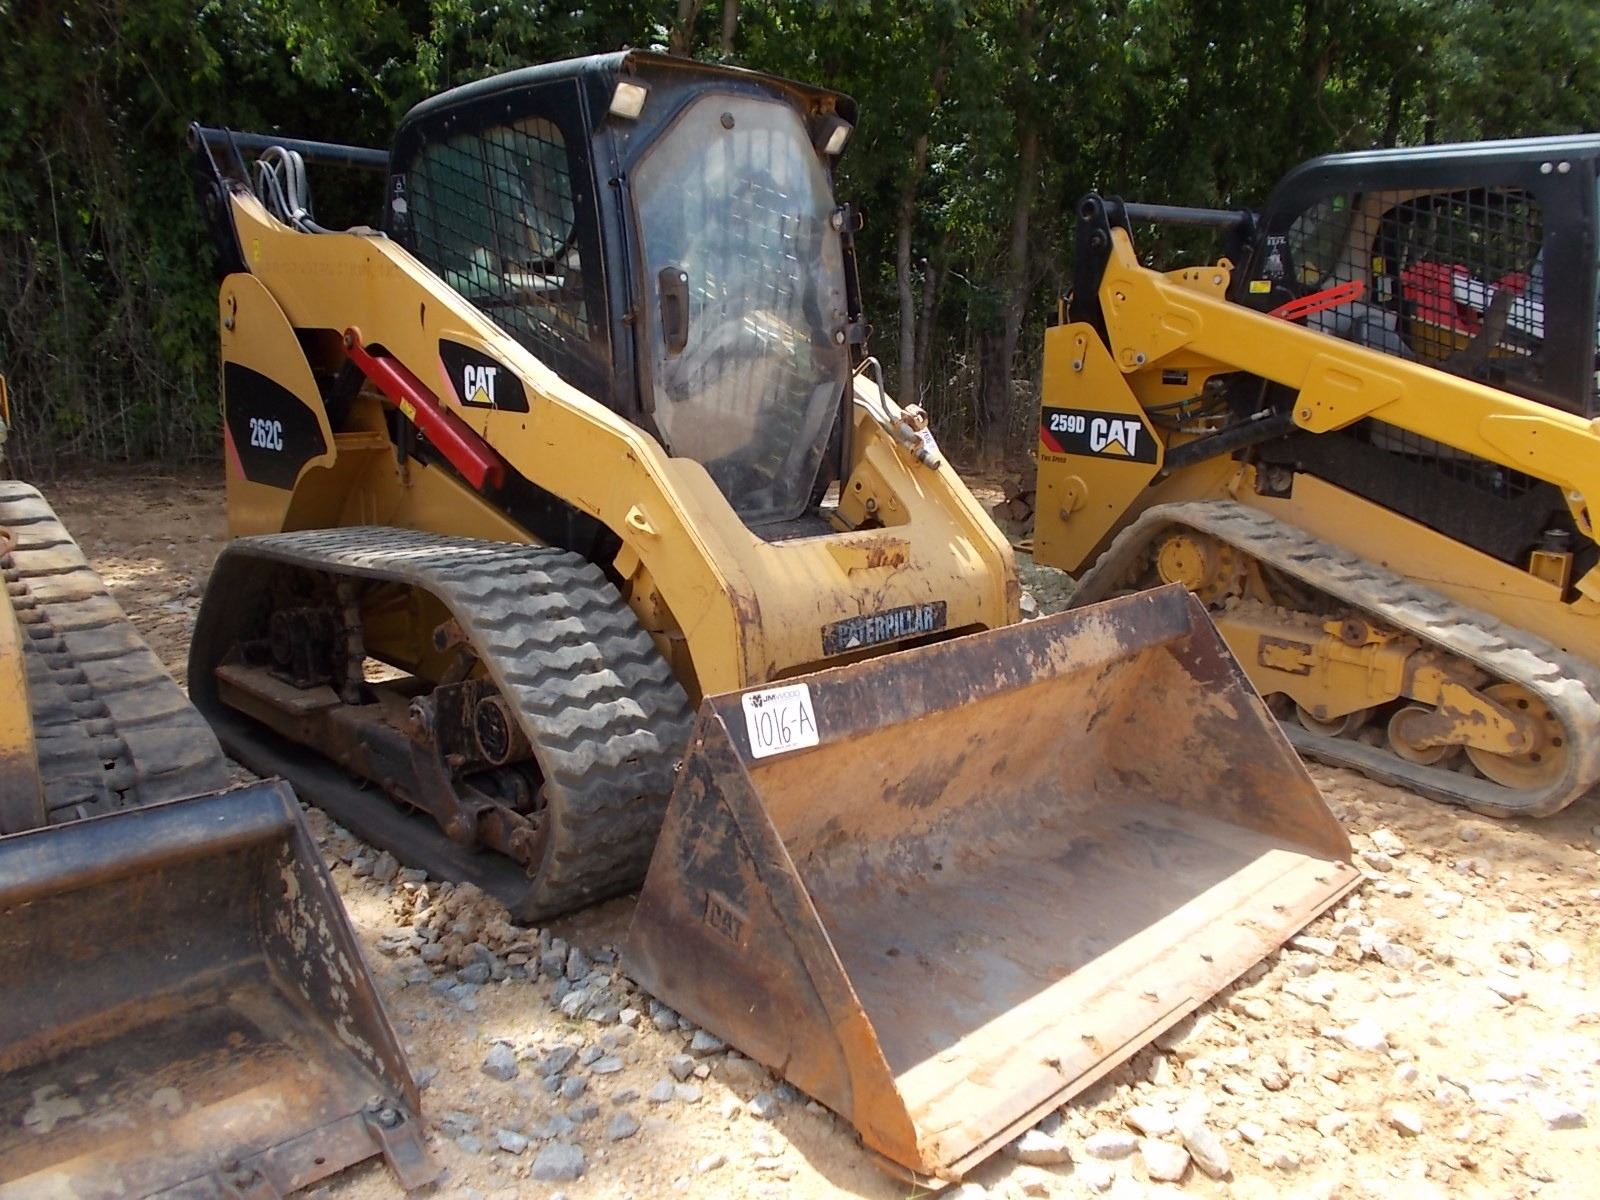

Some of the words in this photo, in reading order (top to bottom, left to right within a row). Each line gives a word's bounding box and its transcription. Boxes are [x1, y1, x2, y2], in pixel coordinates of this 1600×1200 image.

[464, 364, 497, 402] CAT
[250, 416, 283, 451] 262C
[1050, 413, 1086, 434] 259D
[1090, 418, 1142, 457] CAT
[753, 700, 815, 748] 1016-A
